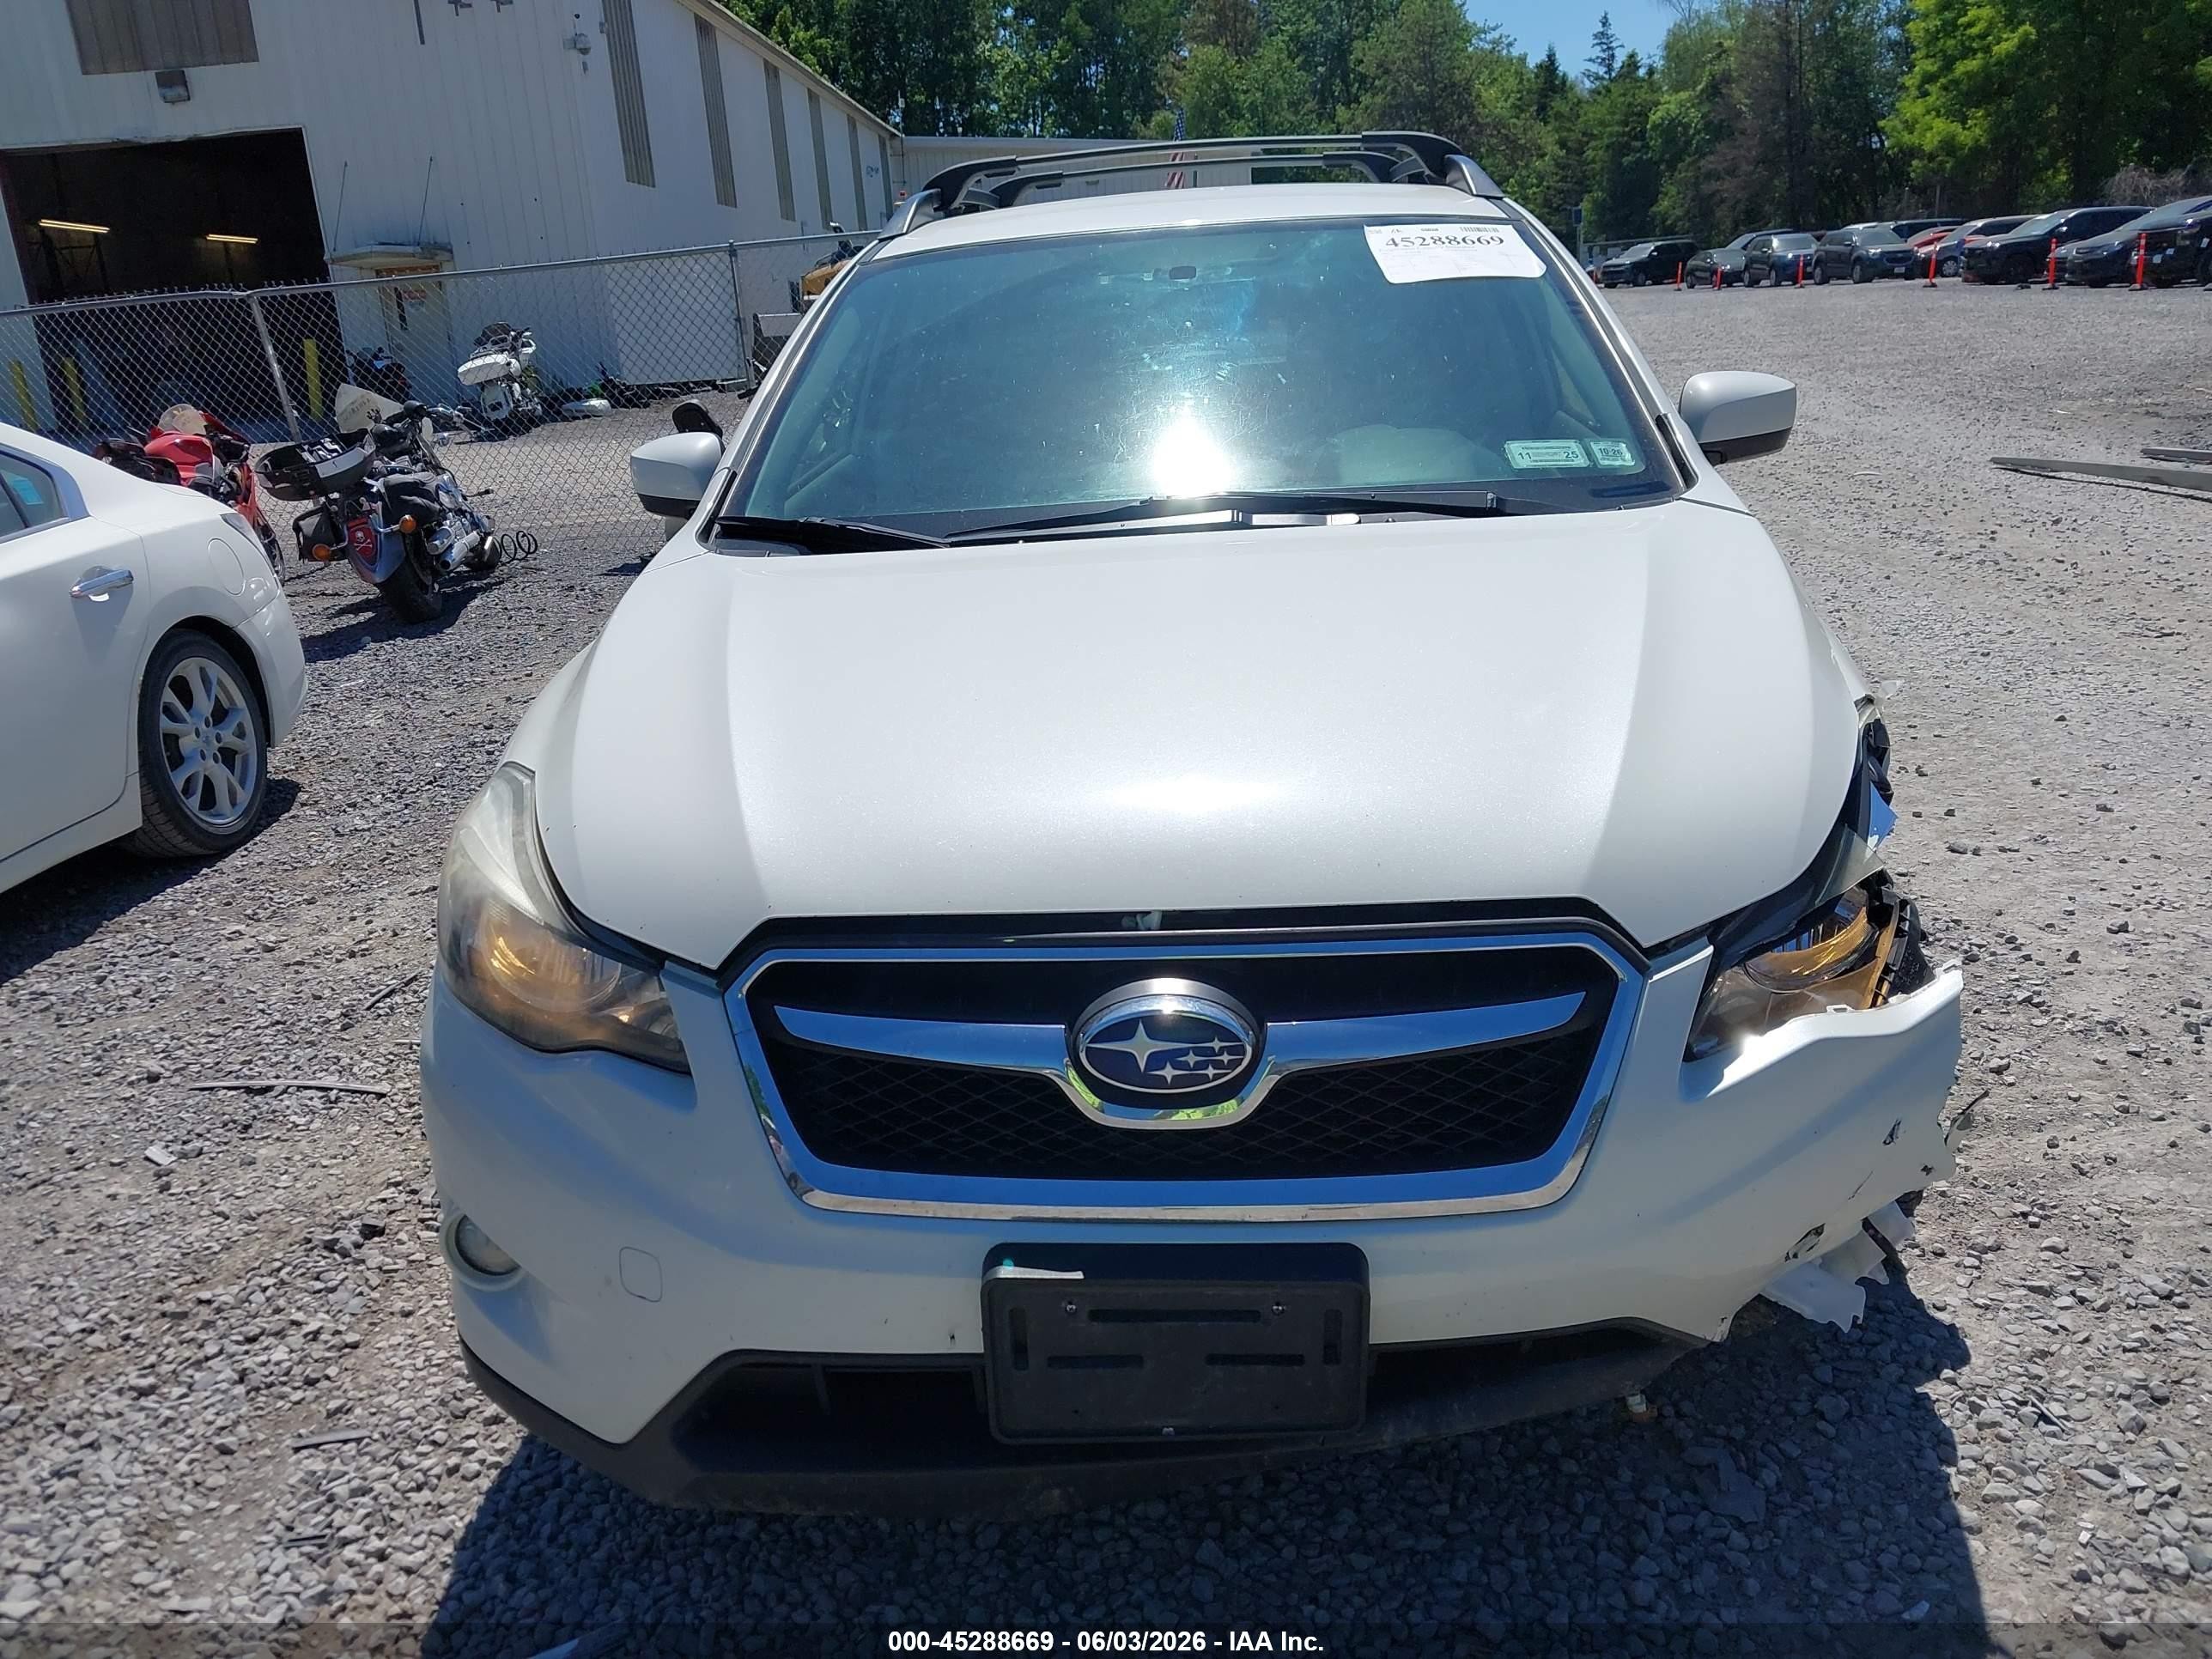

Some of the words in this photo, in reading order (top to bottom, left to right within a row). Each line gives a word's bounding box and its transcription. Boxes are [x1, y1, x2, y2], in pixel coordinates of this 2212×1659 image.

[1385, 235, 1504, 247] 45288669
[1517, 452, 1532, 460] 11
[1563, 451, 1579, 459] 25
